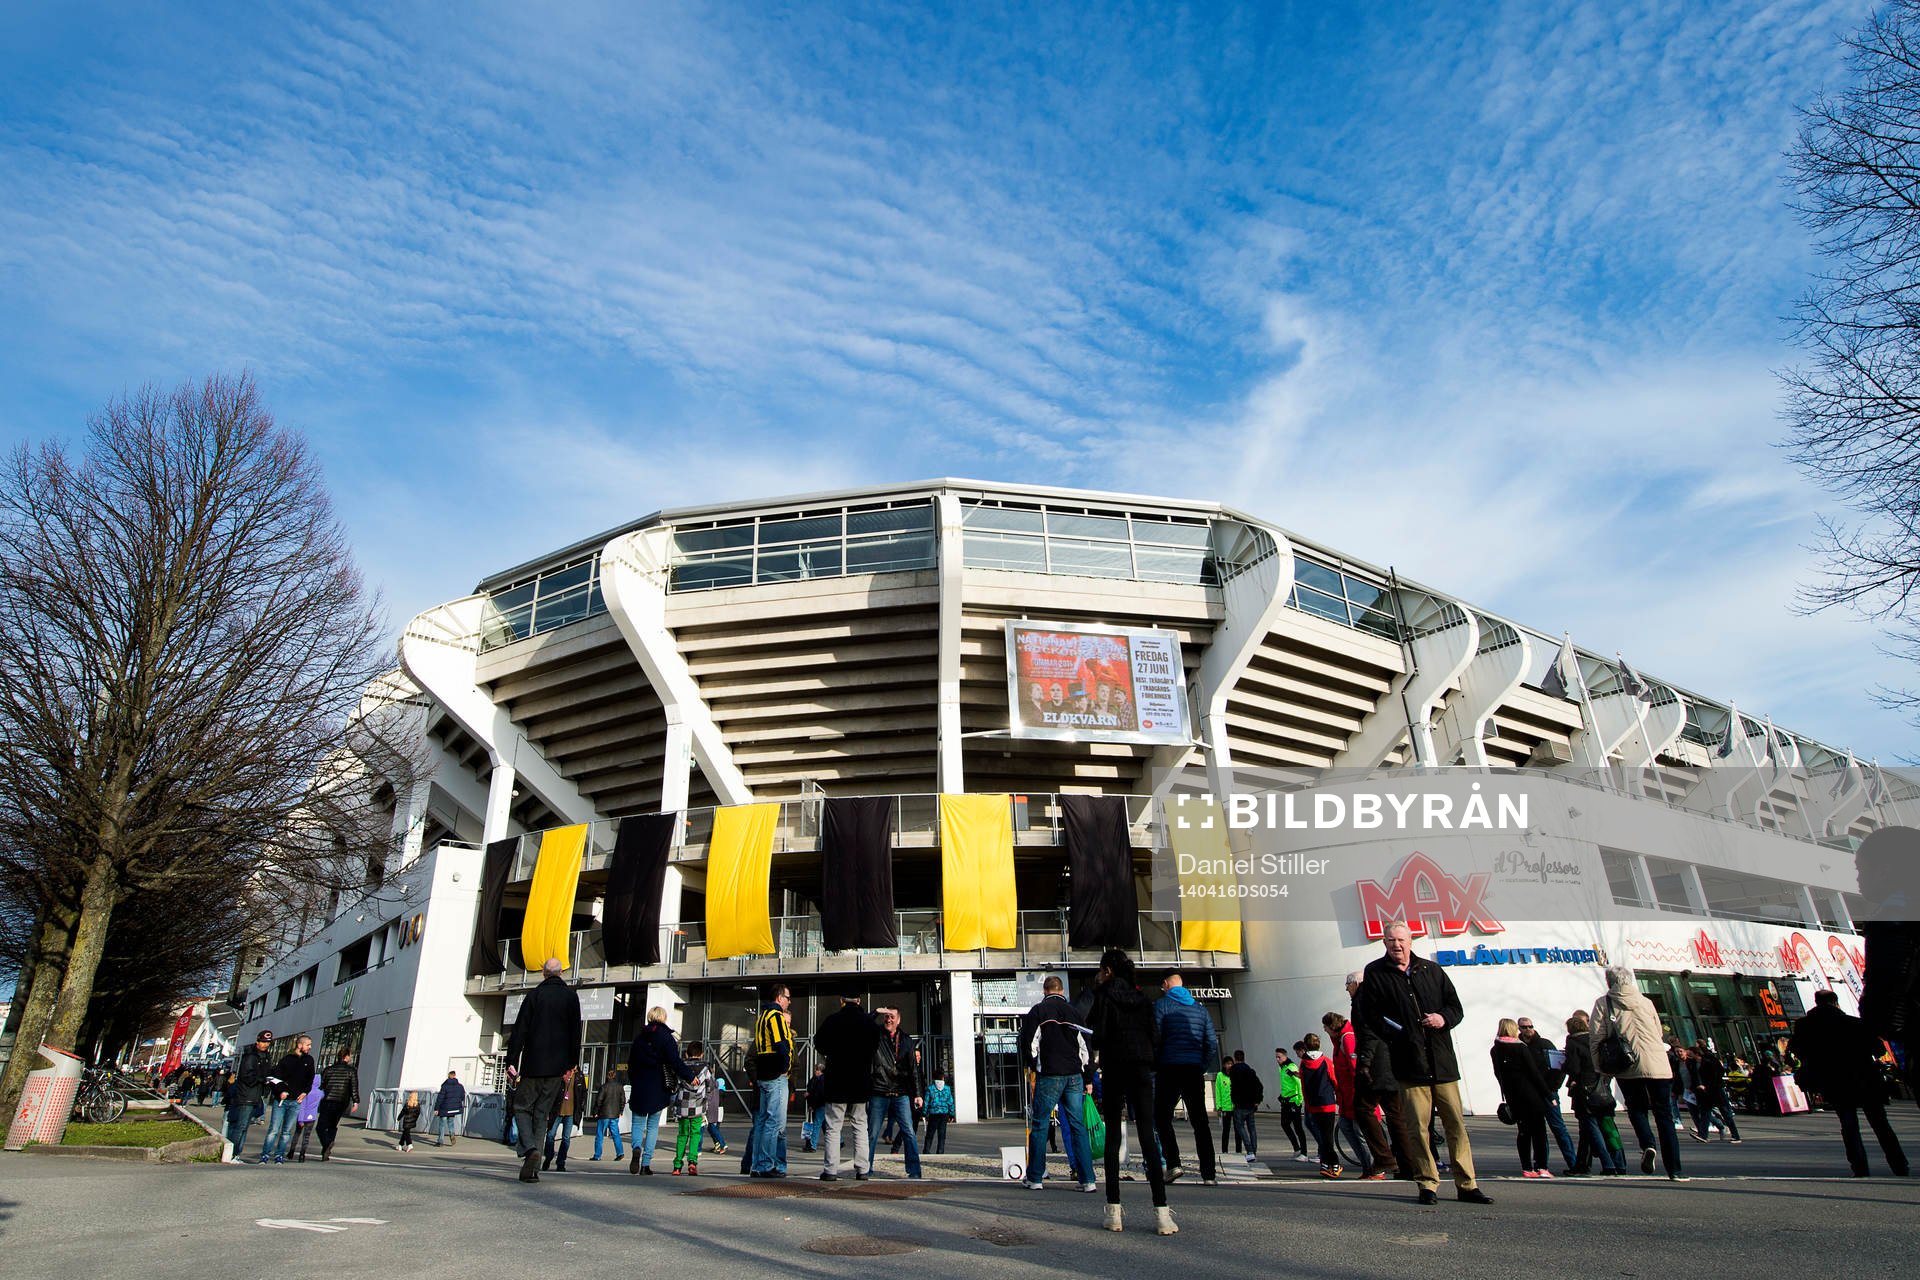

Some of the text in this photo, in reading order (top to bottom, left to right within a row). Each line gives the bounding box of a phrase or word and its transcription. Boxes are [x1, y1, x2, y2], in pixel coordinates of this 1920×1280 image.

[1135, 650, 1169, 662] FREDAG
[1138, 663, 1169, 674] 27 JUNI
[1043, 711, 1118, 726] ELDKVARN
[1506, 850, 1581, 884] Professore
[1356, 851, 1505, 940] MAX
[1694, 929, 1725, 966] MAX
[590, 988, 598, 1000] 4
